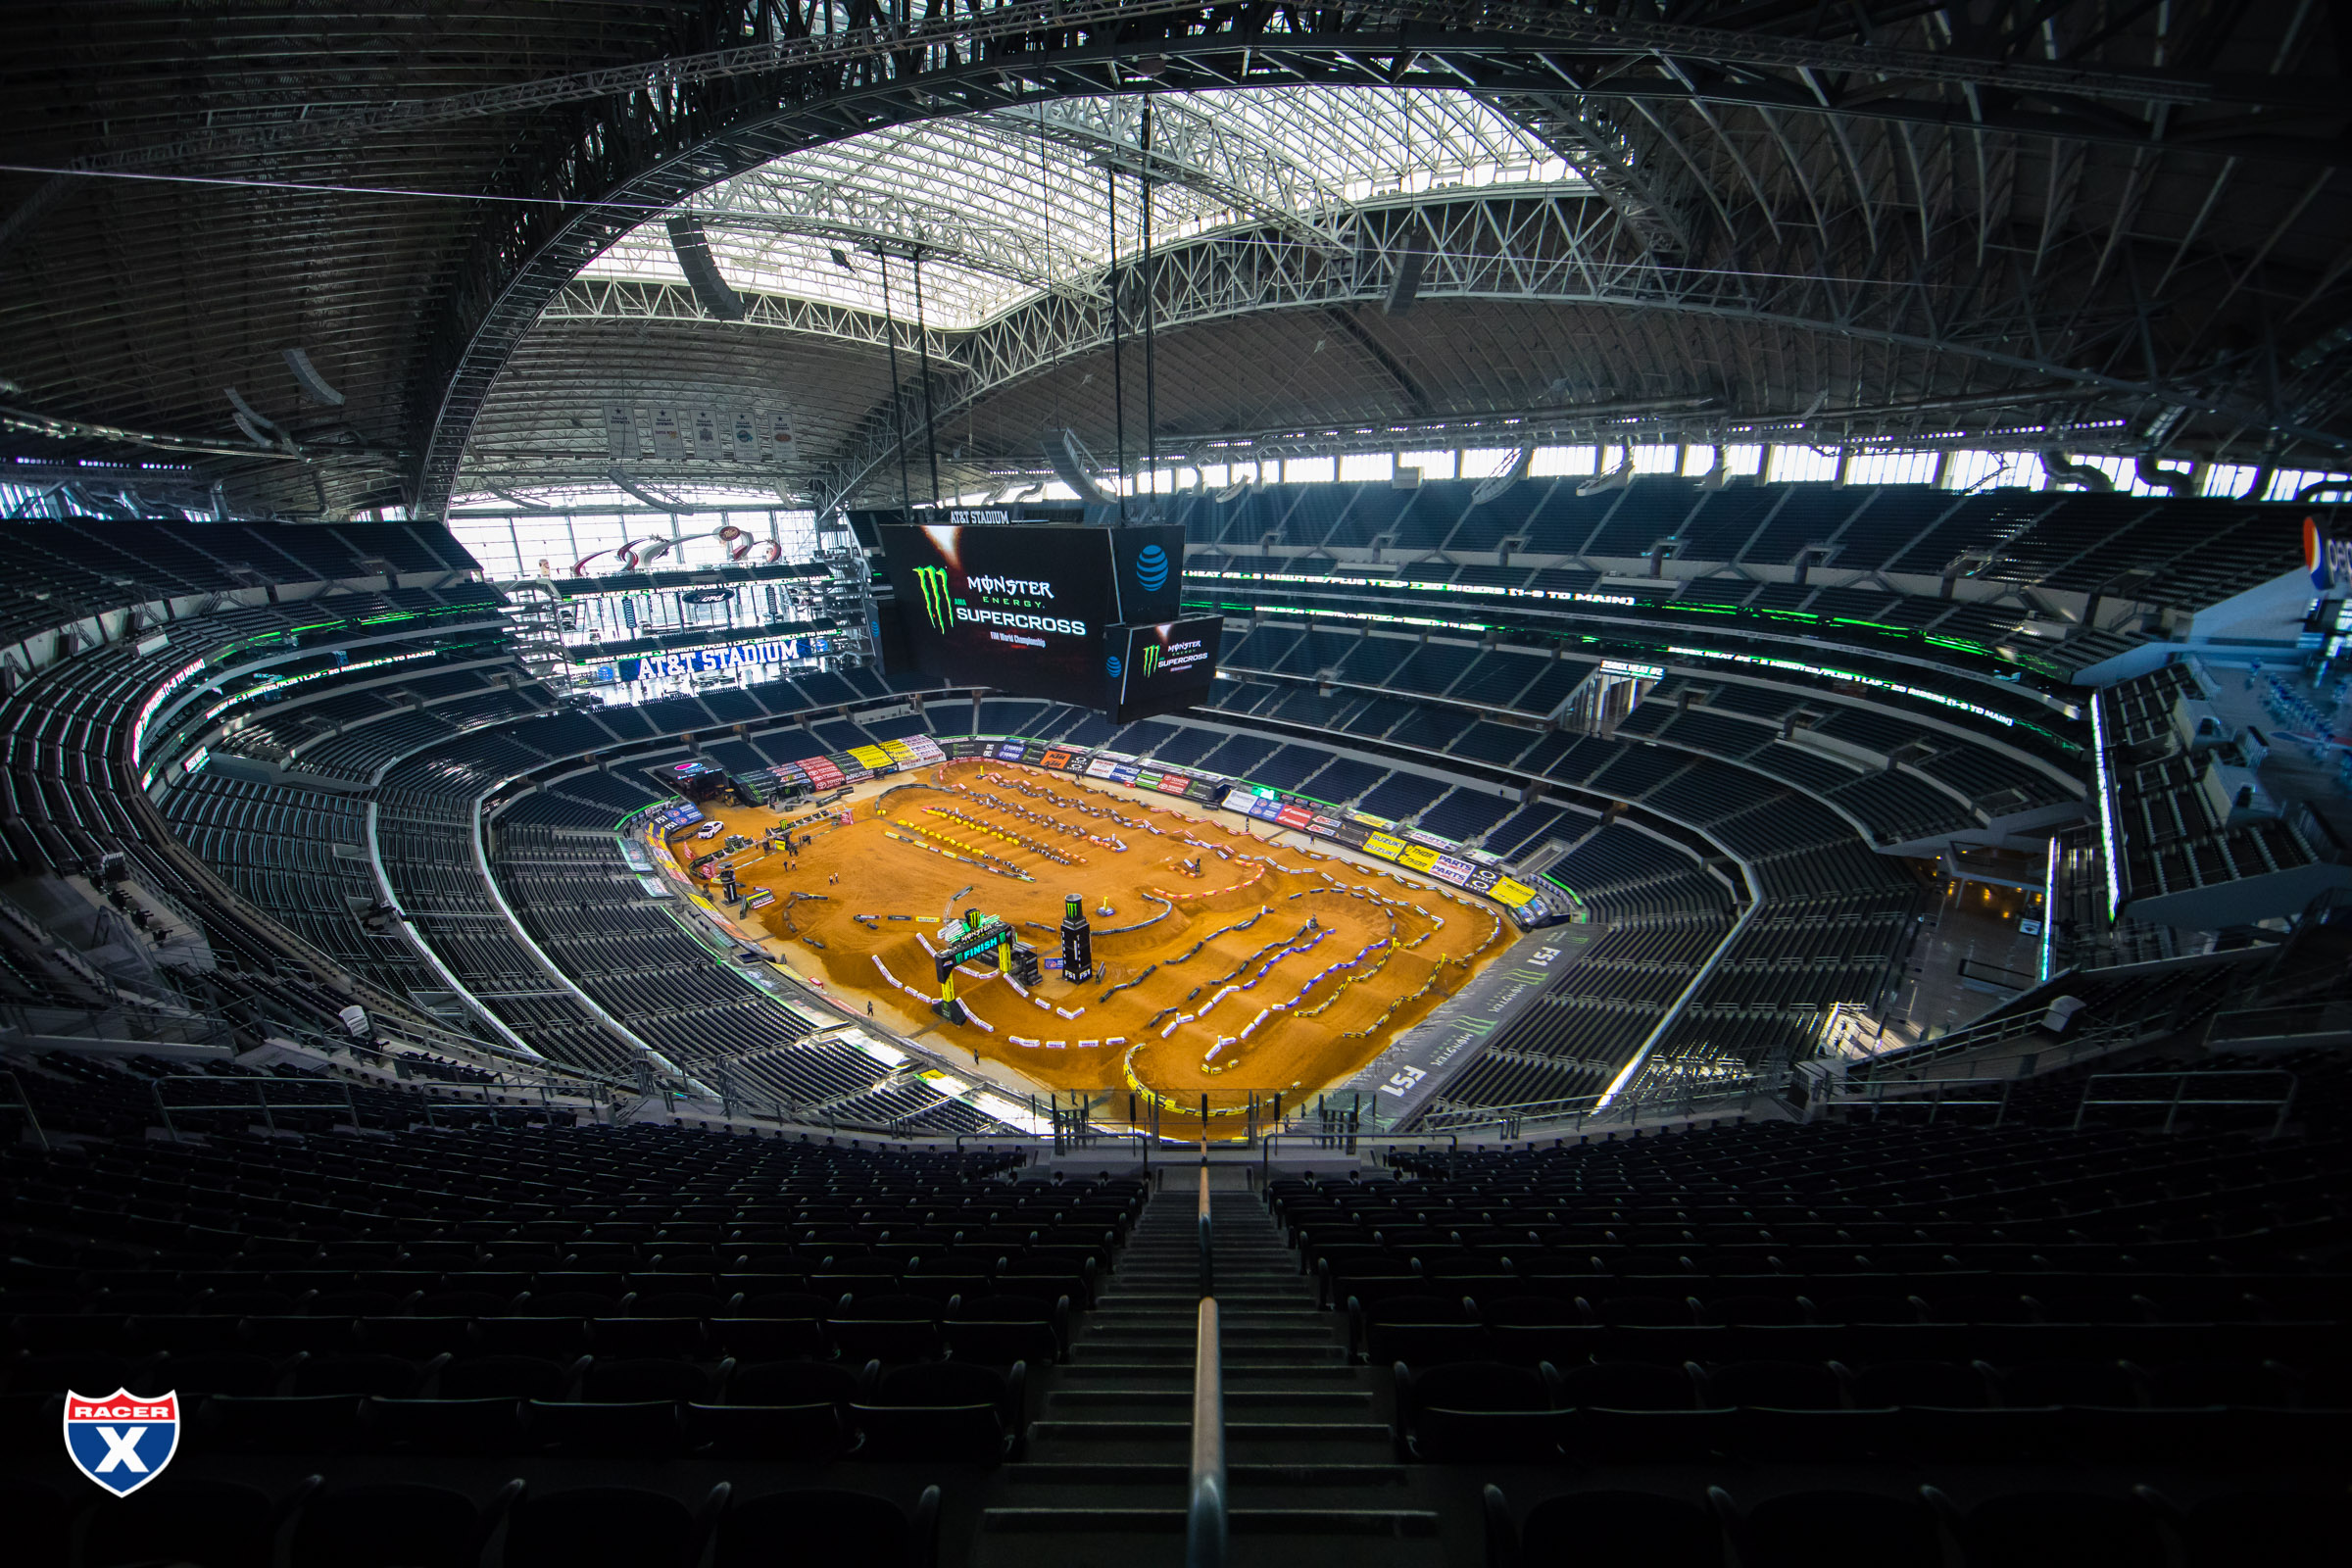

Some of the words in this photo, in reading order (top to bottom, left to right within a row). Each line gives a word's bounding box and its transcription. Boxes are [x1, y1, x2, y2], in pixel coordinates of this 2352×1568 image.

[951, 510, 970, 524] AT&T
[970, 511, 1010, 524] STADIUM
[967, 575, 1054, 599] MONSTER
[693, 591, 726, 602] Ford
[1547, 591, 1571, 599] TO
[982, 596, 1042, 608] ENERGY
[956, 608, 1086, 636] SUPERCROSS
[1000, 633, 1014, 642] World
[1168, 640, 1201, 652] MONSTER
[638, 652, 696, 680] AT&T
[702, 639, 799, 671] STADIUM
[1158, 652, 1208, 668] SUPERCROSS
[1628, 663, 1650, 674] HEAT
[175, 671, 186, 684] TO
[303, 672, 321, 681] LAP
[1862, 677, 1884, 686] LAP
[1969, 705, 1984, 715] TO
[1049, 751, 1066, 760] KTM
[654, 815, 669, 824] FS1
[664, 821, 679, 830] FS1
[1372, 834, 1404, 849] SUZUKI
[1365, 843, 1397, 857] SUZUKI
[1411, 847, 1435, 859] THOR
[1404, 857, 1428, 868] THOR
[1438, 854, 1473, 871] PARTS
[1431, 864, 1466, 881] PARTS
[964, 937, 997, 960] FINISH
[1527, 946, 1562, 967] FS1
[1065, 969, 1076, 980] FS1
[1079, 968, 1091, 980] FS1
[1379, 1065, 1427, 1097] FS1
